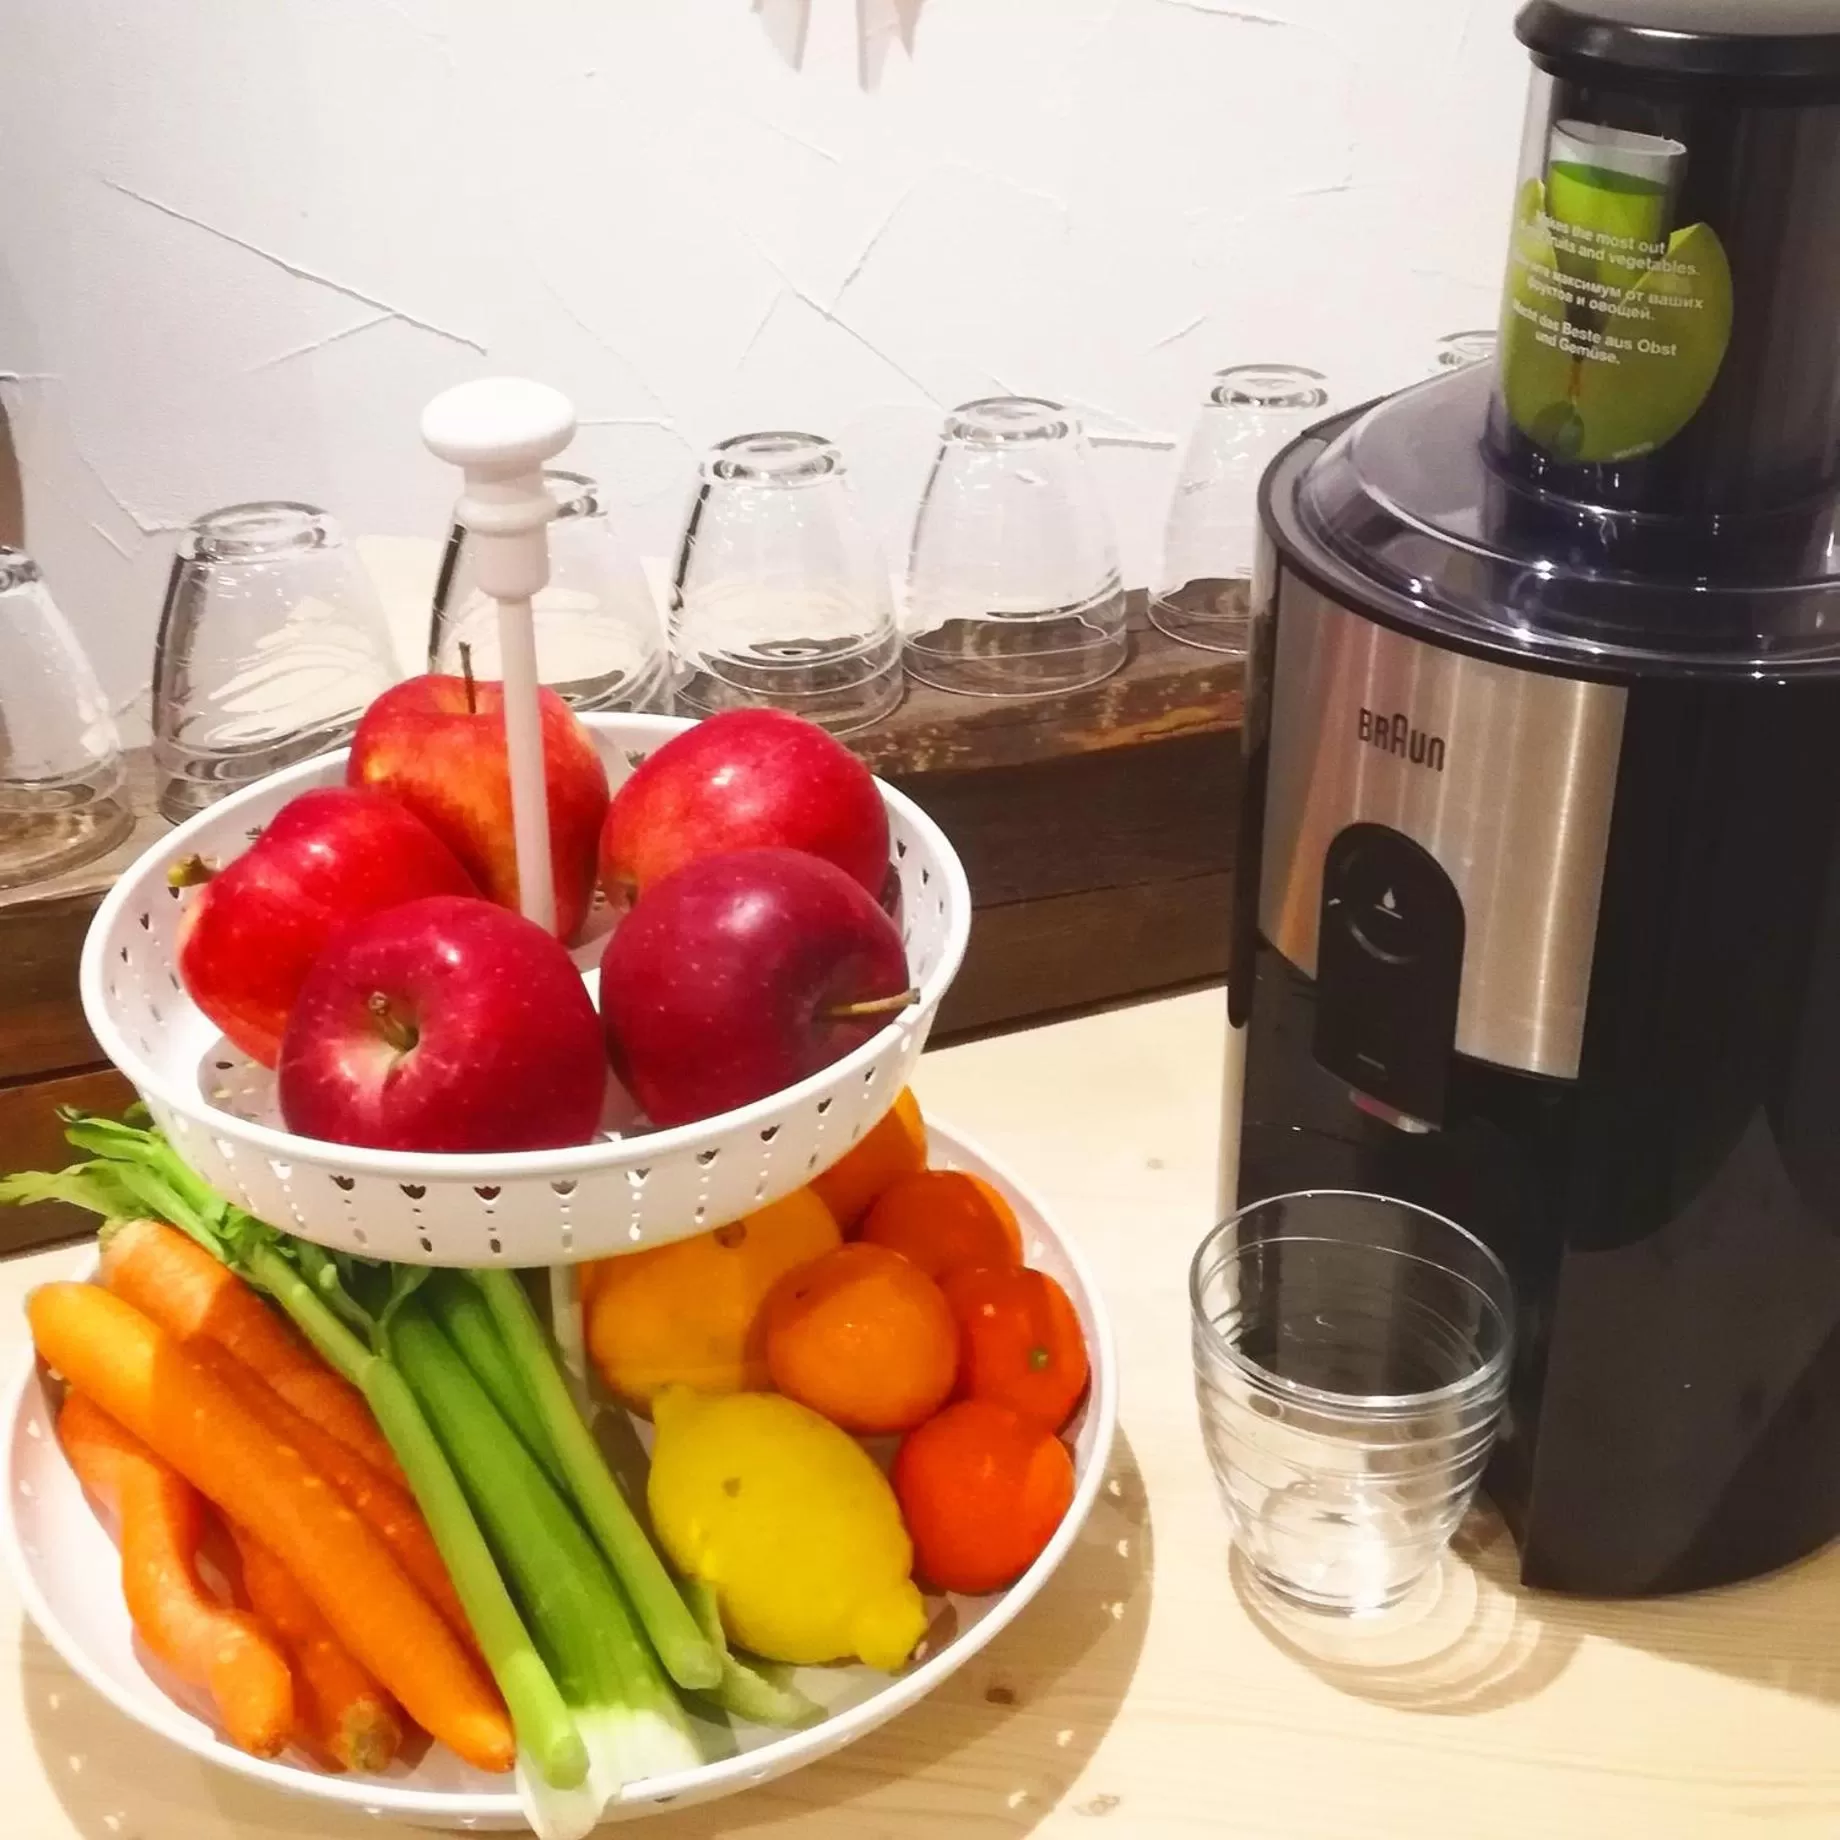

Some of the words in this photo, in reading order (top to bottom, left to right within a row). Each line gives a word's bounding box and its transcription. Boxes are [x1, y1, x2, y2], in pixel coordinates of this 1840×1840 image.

[1572, 224, 1594, 242] the
[1595, 233, 1635, 249] most
[1638, 241, 1666, 254] out
[1578, 244, 1605, 262] and
[1608, 252, 1700, 277] vegetables.
[1576, 295, 1587, 307] и
[1589, 299, 1655, 321] овощей.
[1625, 289, 1644, 302] от
[1648, 293, 1704, 310] ваших
[1535, 330, 1557, 348] und
[1559, 337, 1621, 365] Gemüse.
[1562, 320, 1602, 344] Beste
[1604, 336, 1633, 351] aus
[1637, 338, 1678, 356] Obst
